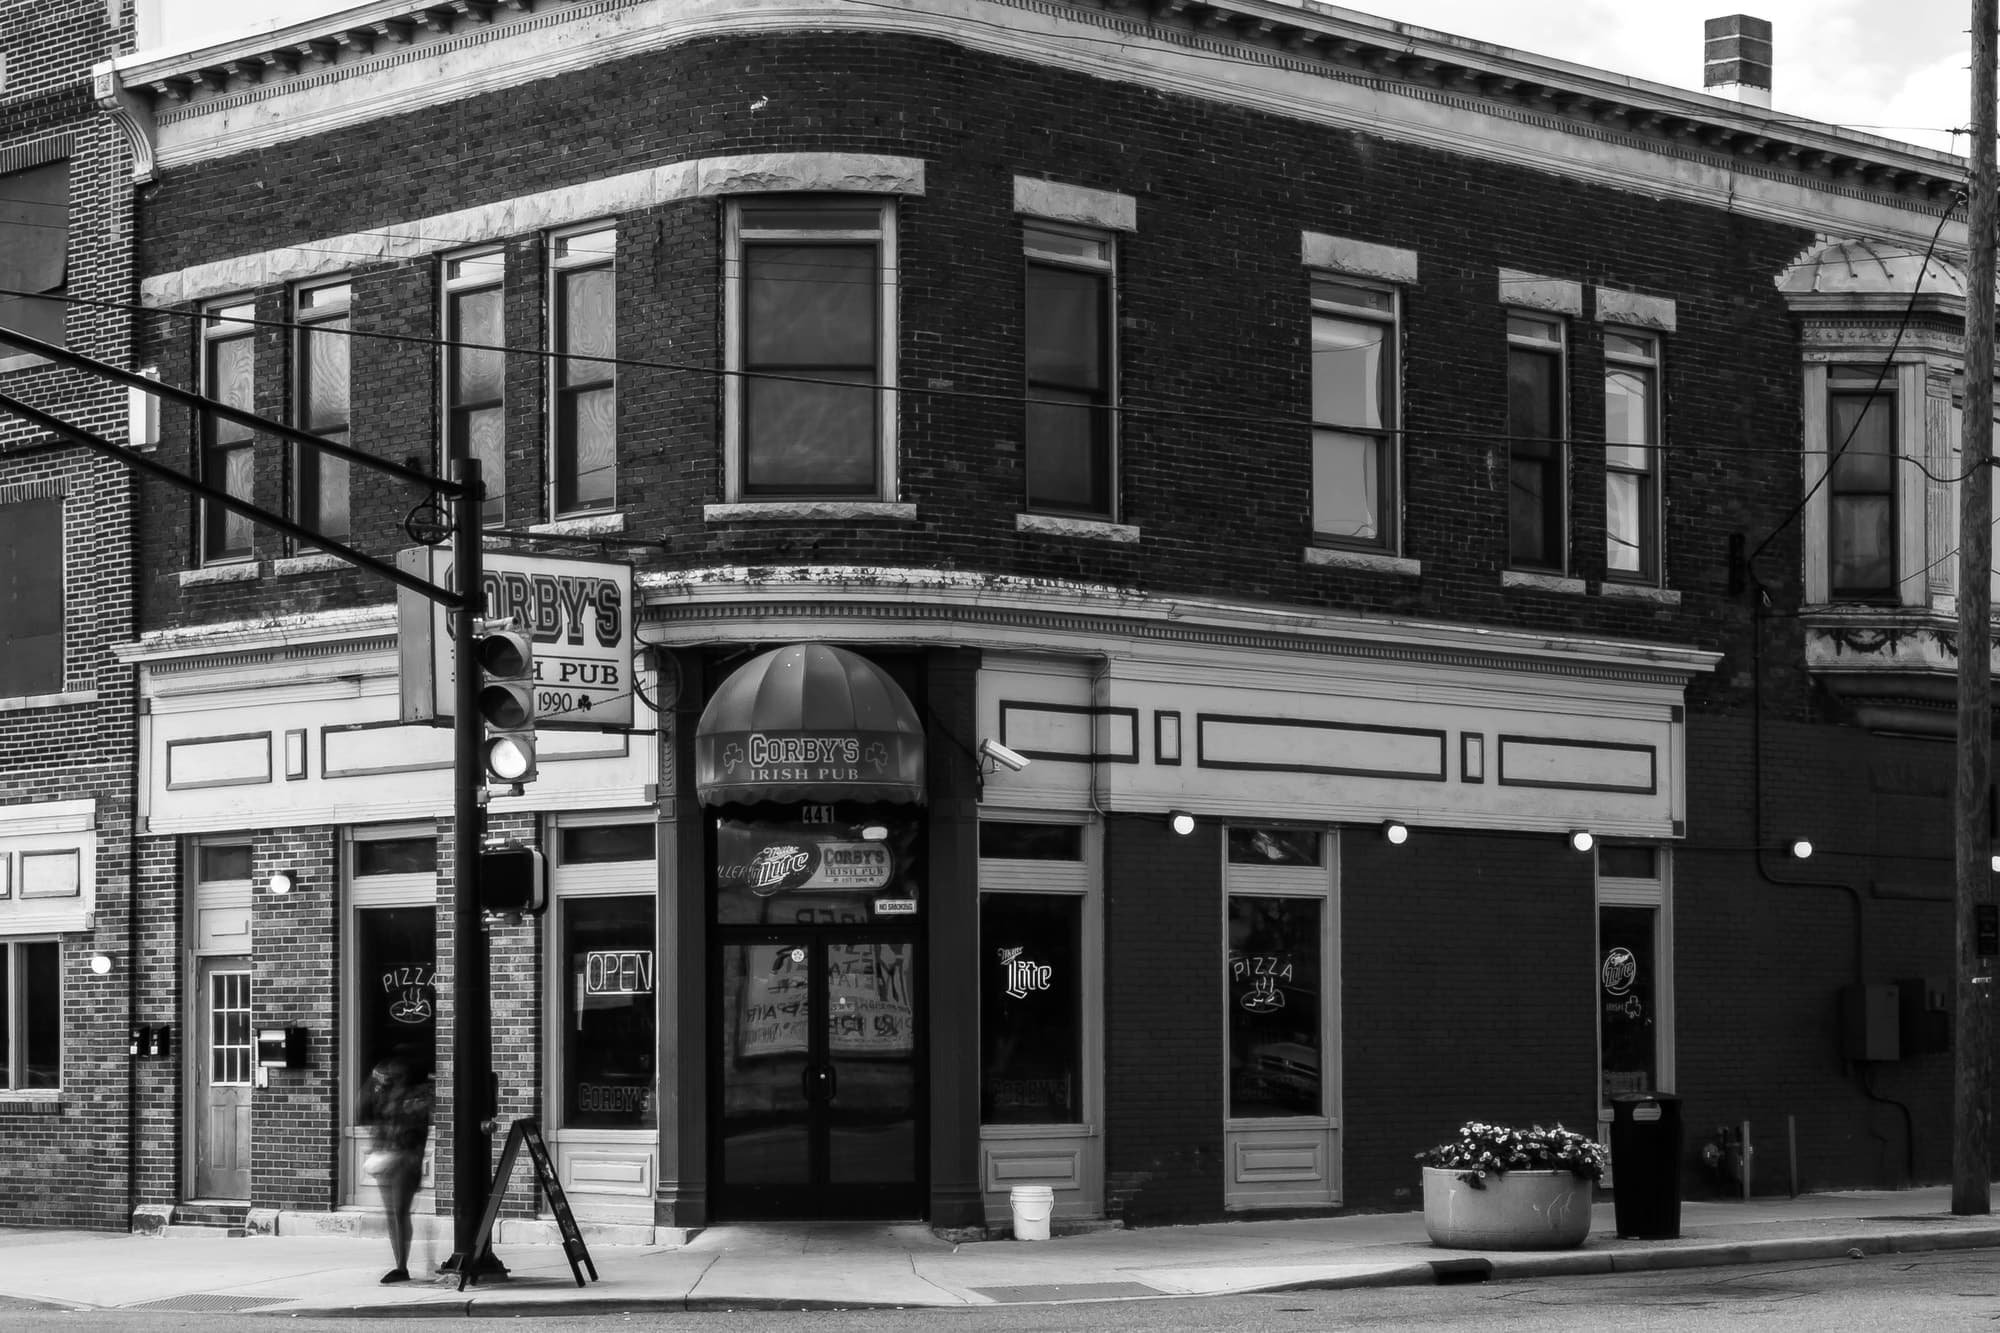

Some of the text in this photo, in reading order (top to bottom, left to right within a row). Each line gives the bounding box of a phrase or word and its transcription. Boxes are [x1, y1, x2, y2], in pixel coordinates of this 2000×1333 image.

[445, 563, 622, 648] ORBY'S
[559, 662, 620, 685] PUB
[537, 692, 573, 713] 1990
[748, 733, 860, 768] CORBY'S
[750, 768, 860, 782] IRISH PUB
[803, 806, 834, 824] 441
[823, 849, 885, 866] CORBY'S
[825, 867, 883, 876] IRISH PUB
[878, 903, 913, 911] NO SMOKING
[588, 953, 653, 991] OPEN
[1005, 960, 1053, 999] Lite
[1233, 956, 1294, 984] PIZZA
[578, 1082, 650, 1113] CORBY'S
